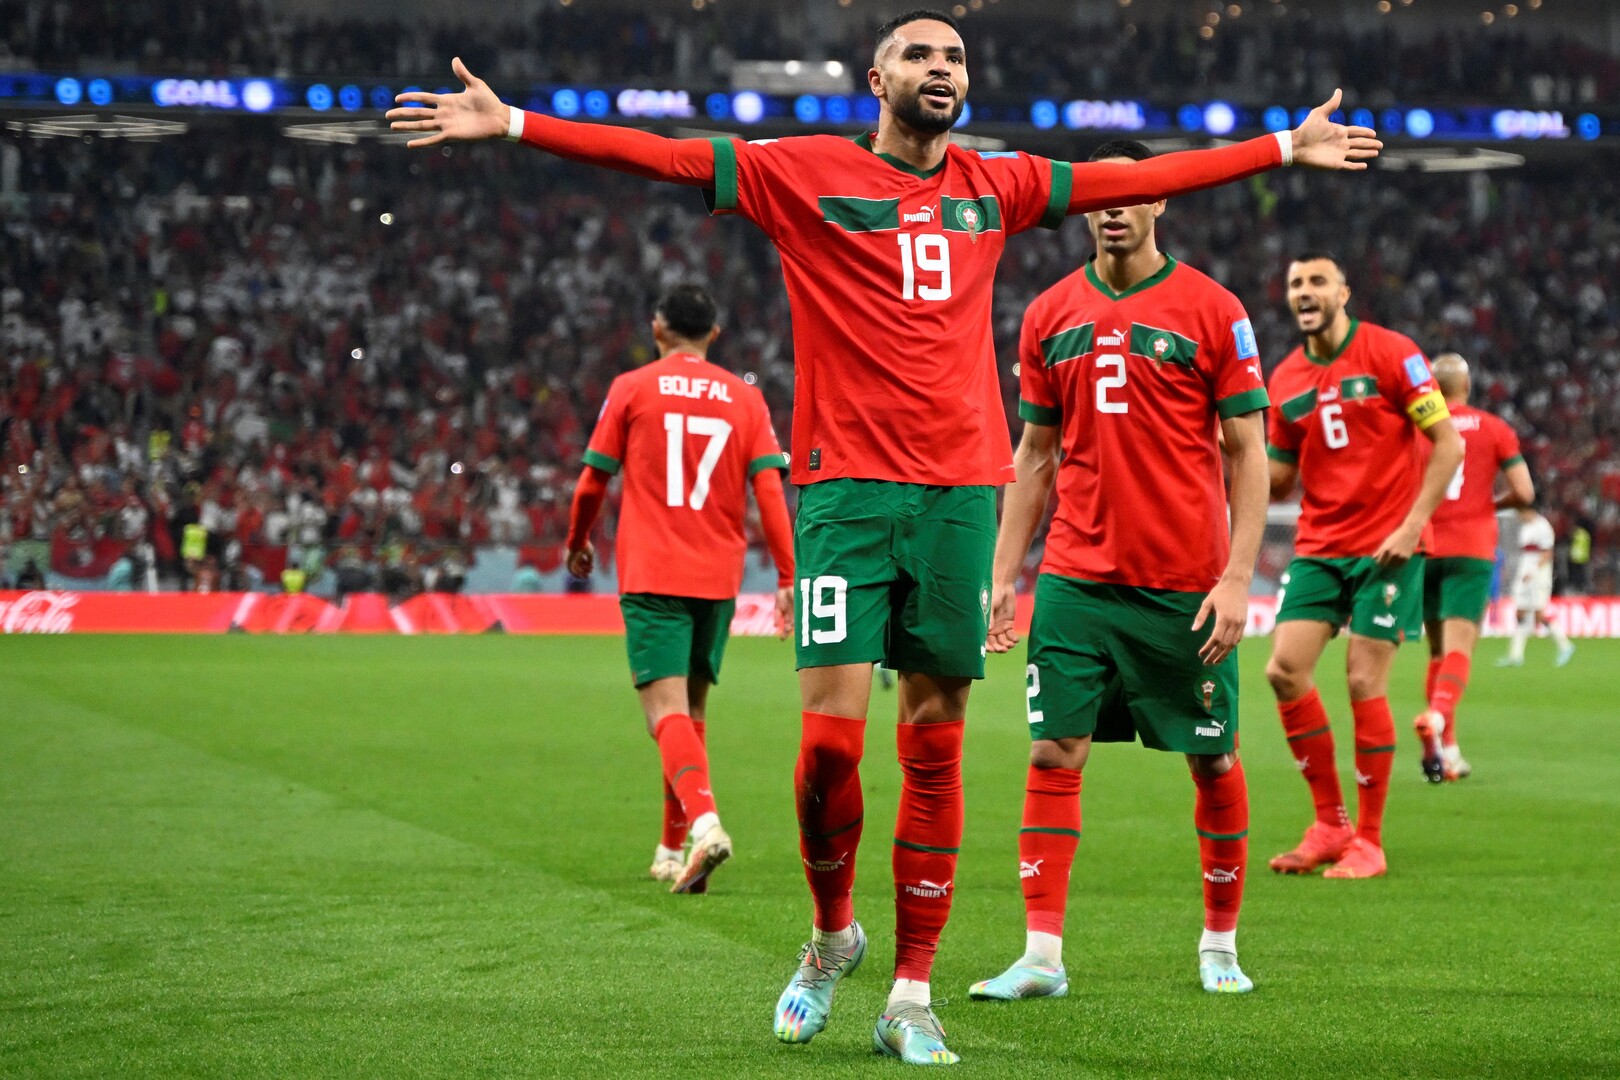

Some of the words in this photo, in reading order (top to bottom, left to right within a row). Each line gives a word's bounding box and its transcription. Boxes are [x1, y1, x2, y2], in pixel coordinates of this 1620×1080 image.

[156, 79, 238, 107] GOAL
[1066, 100, 1146, 129] GOAL
[897, 233, 952, 301] 19
[658, 375, 733, 403] BOUFAL
[1095, 354, 1128, 414] 2
[1320, 403, 1349, 450] 6
[664, 412, 733, 511] 17
[800, 575, 848, 647] 19
[1026, 663, 1044, 724] 2
